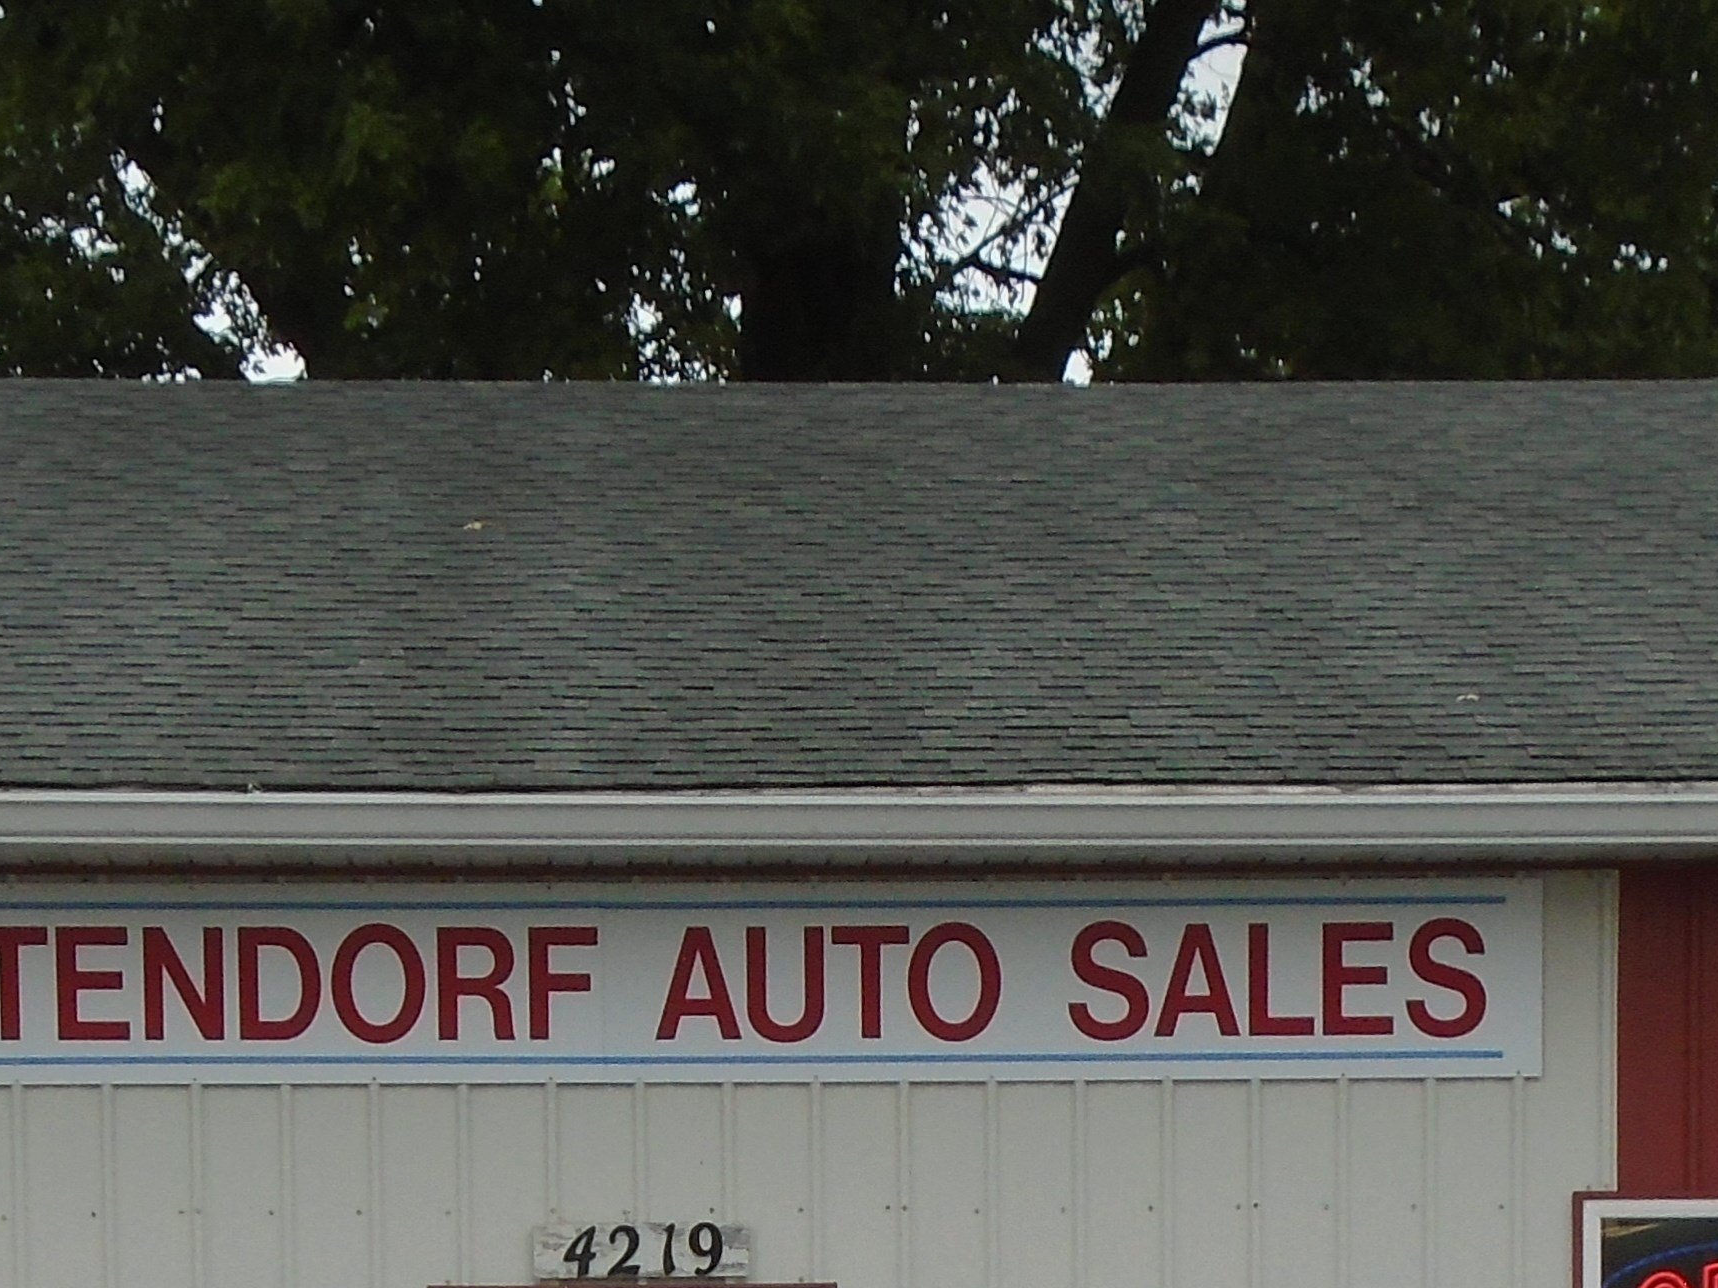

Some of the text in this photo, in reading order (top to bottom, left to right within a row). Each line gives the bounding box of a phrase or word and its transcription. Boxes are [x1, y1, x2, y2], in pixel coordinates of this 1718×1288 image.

[661, 925, 1001, 1042] AUTO
[1072, 921, 1486, 1041] SALES
[563, 1222, 724, 1277] 4219
